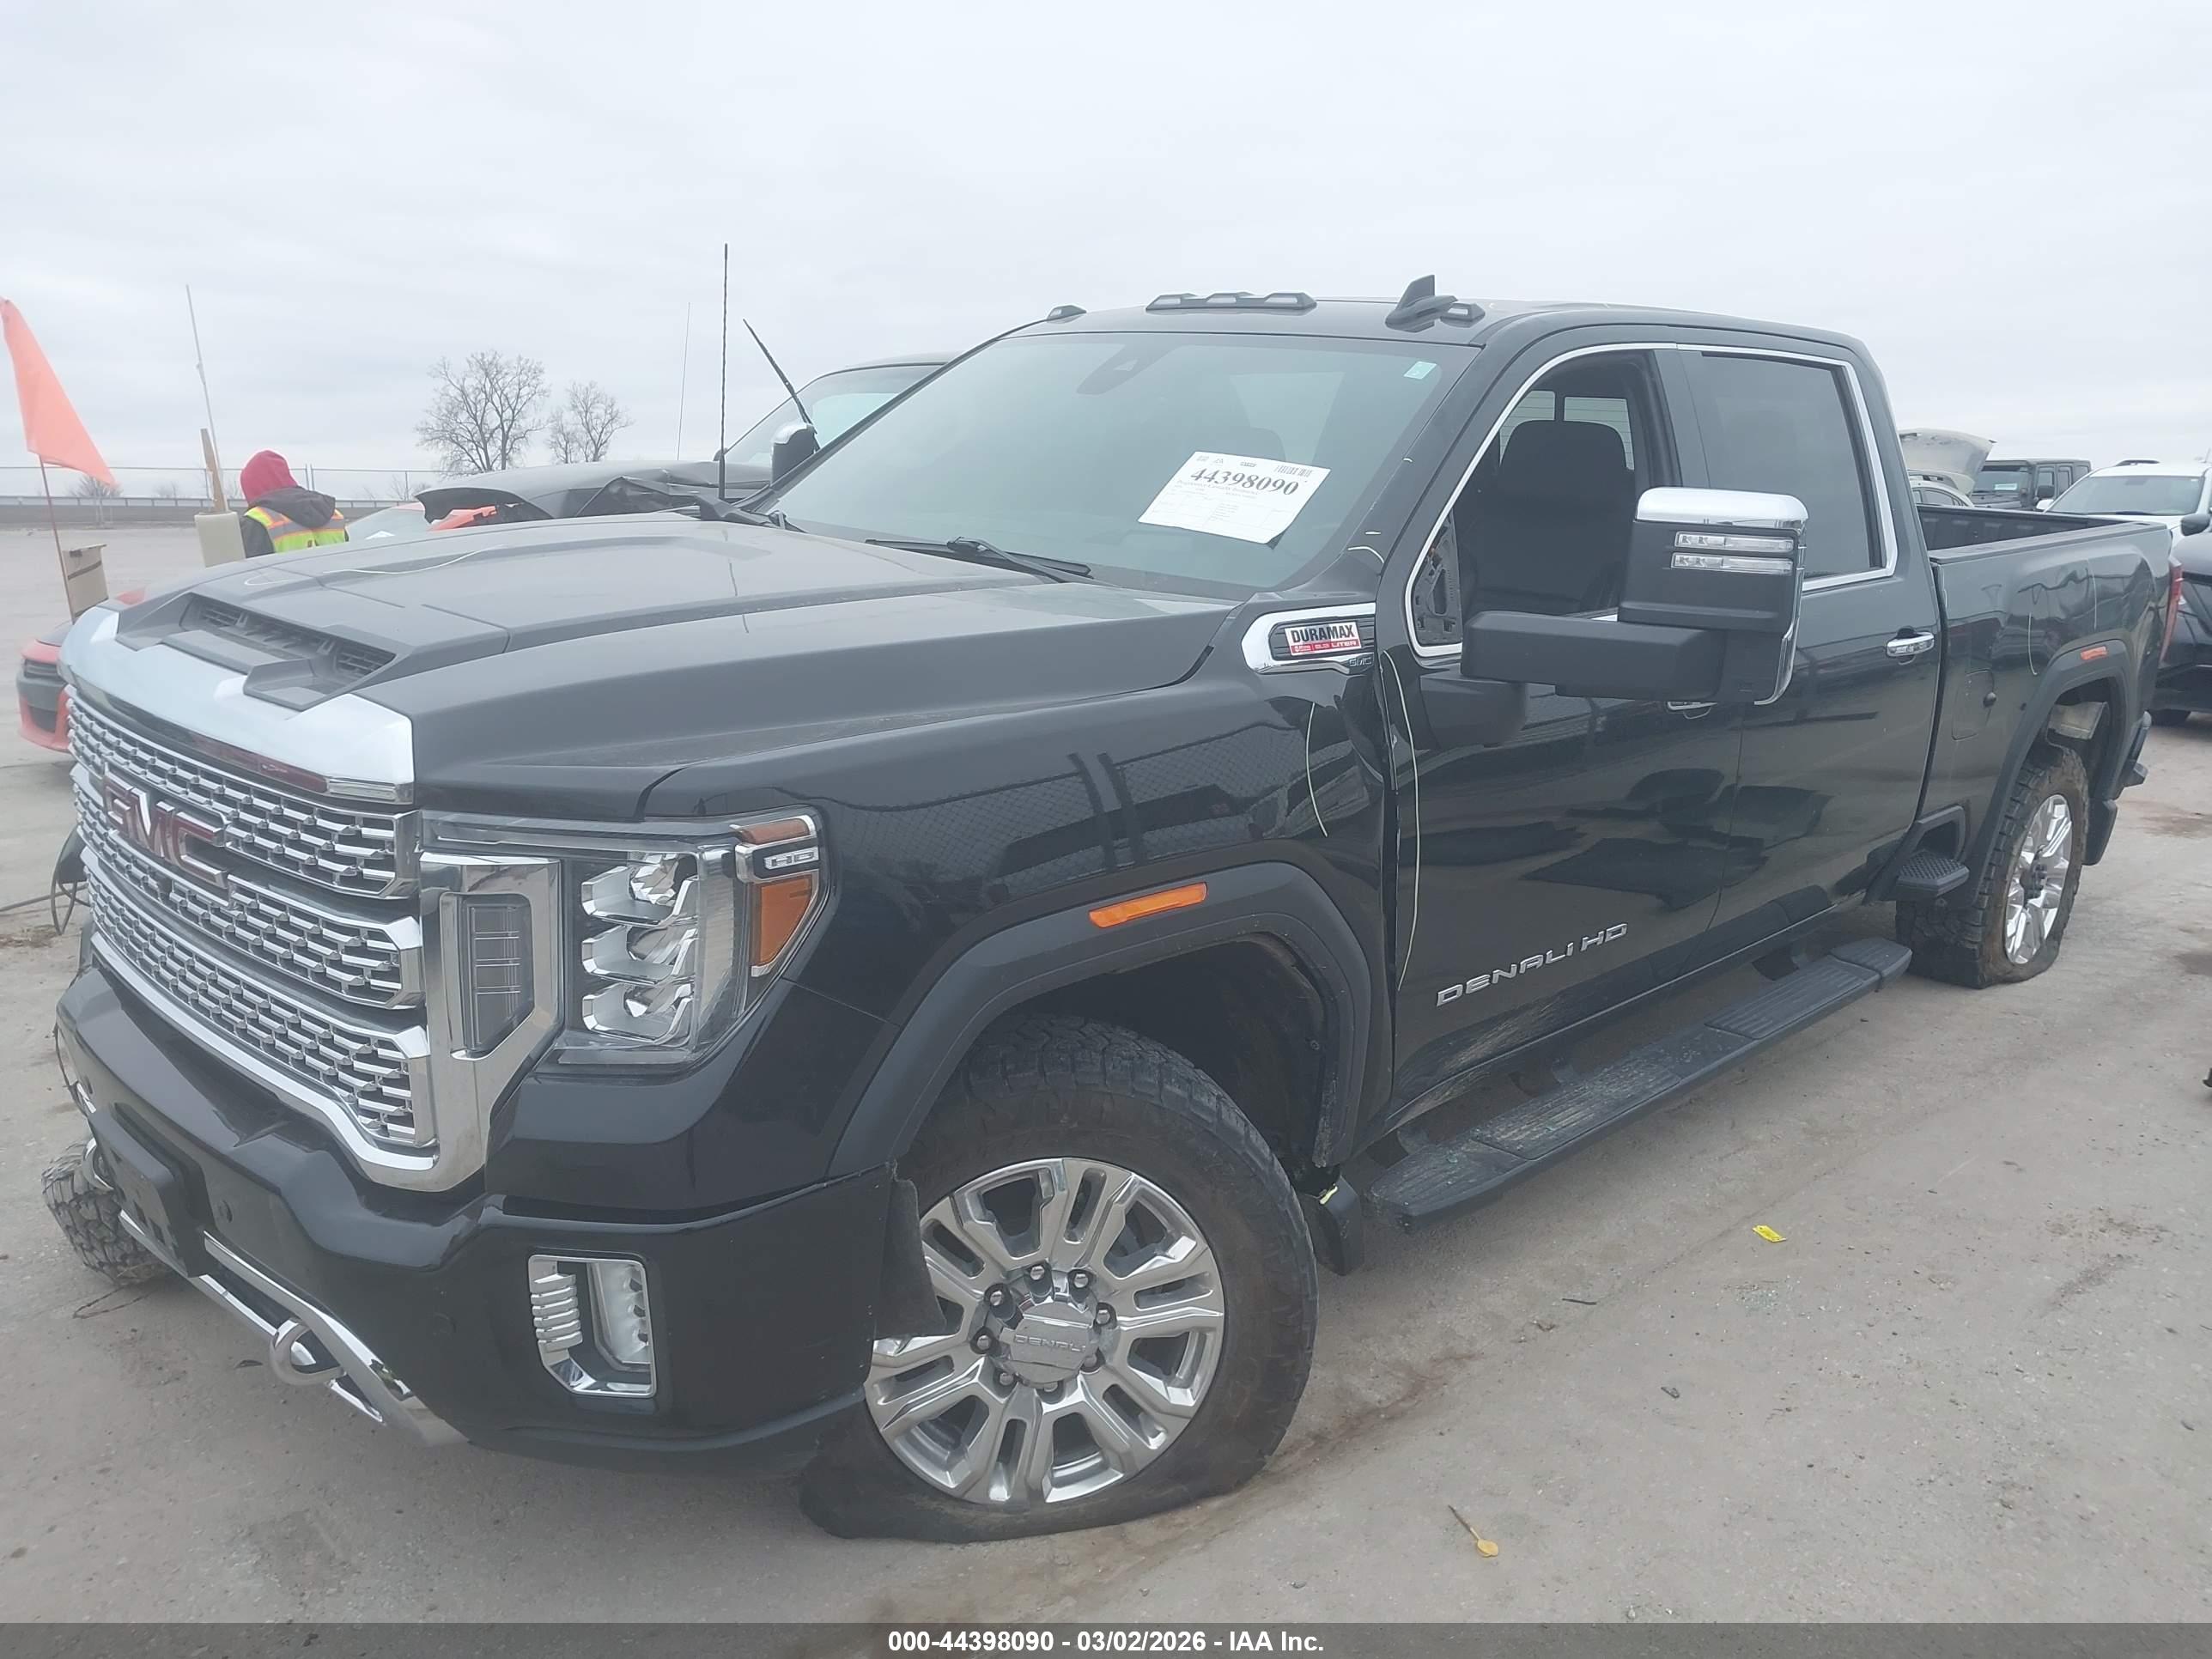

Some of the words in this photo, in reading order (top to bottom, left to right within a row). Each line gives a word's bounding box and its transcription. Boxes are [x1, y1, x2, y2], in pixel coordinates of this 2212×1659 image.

[1190, 467, 1299, 495] 44398090
[1291, 625, 1354, 642] DURAMAX
[103, 764, 231, 889] GMC
[1437, 941, 1574, 1007] DENALI
[1581, 923, 1628, 951] HD
[1014, 1334, 1085, 1352] DENALI
